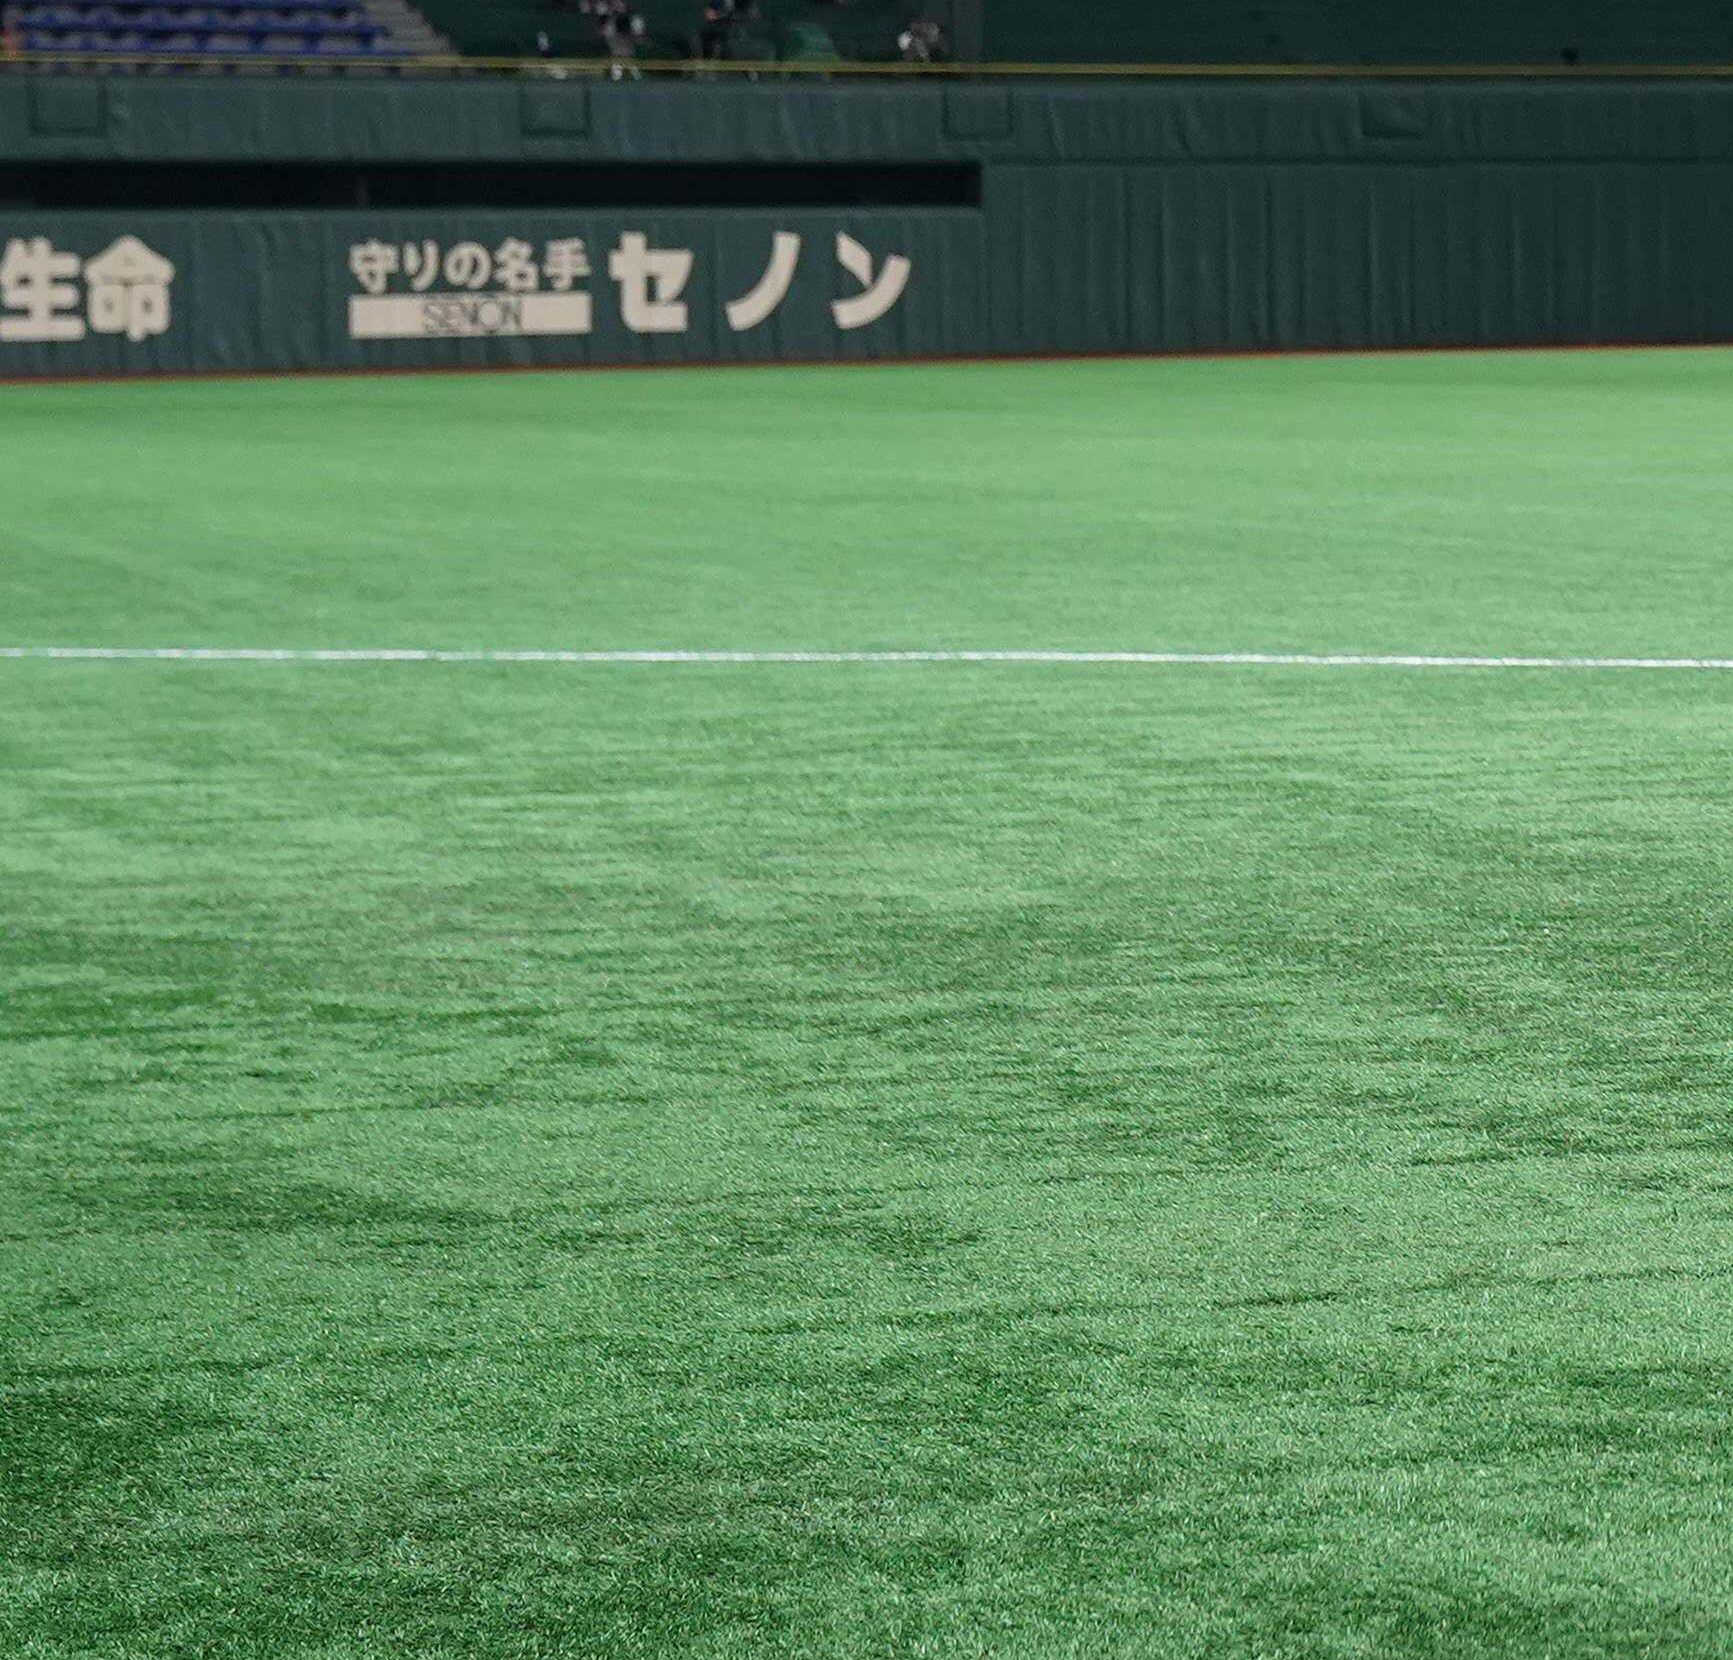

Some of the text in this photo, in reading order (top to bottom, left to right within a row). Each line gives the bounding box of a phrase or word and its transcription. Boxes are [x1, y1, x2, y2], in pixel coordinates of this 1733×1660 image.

[0, 234, 175, 342] 生命
[348, 231, 912, 334] 守りの名手 セノン
